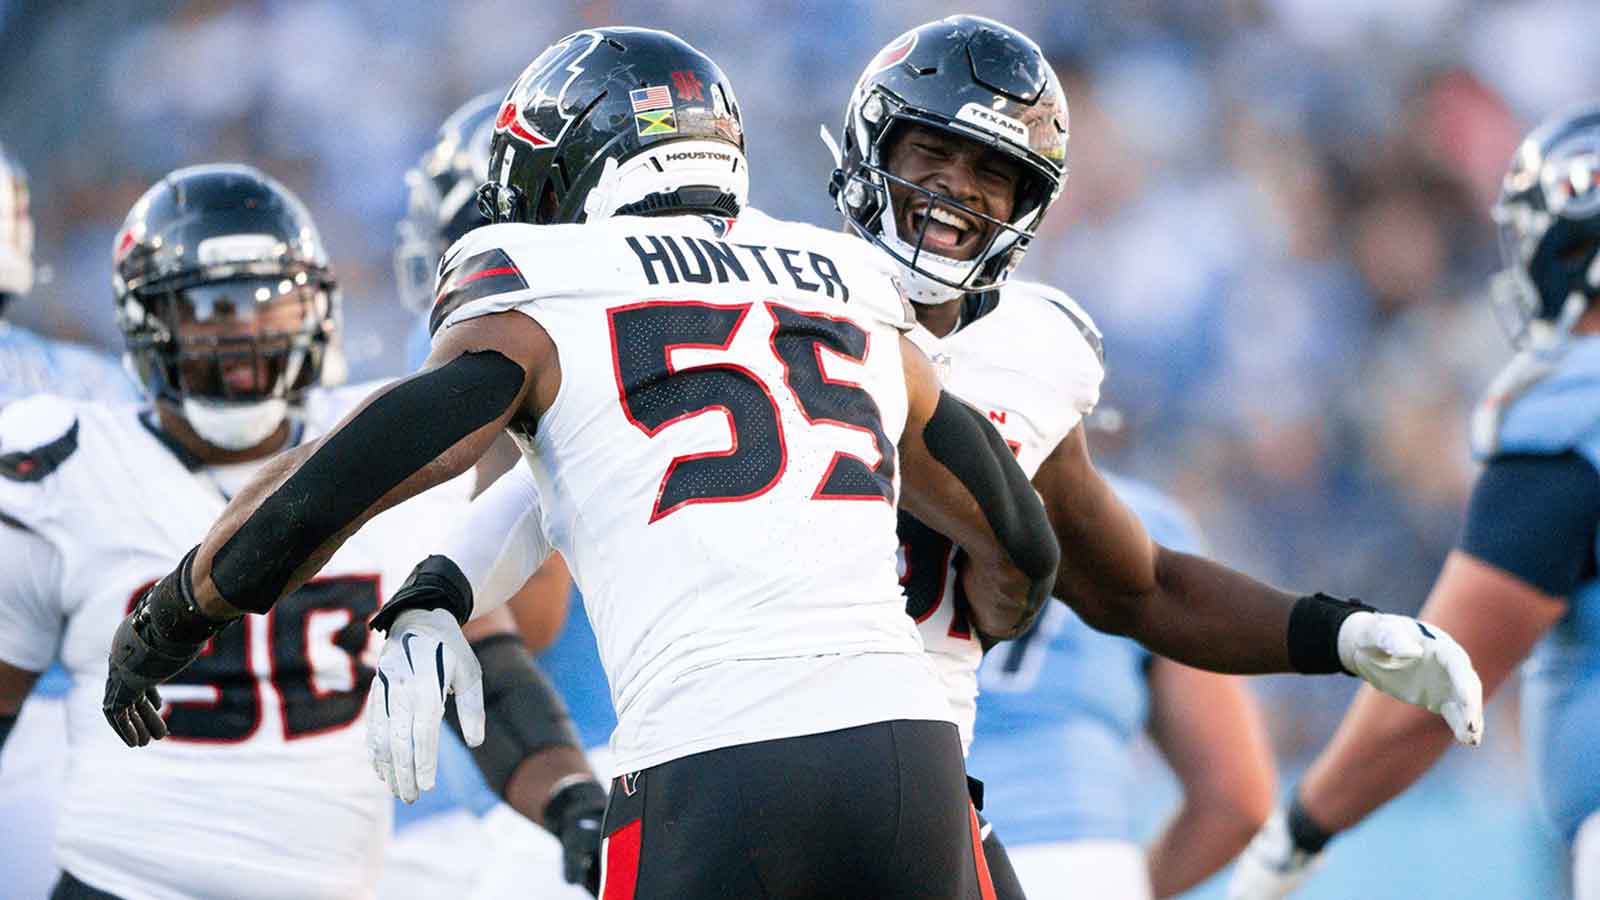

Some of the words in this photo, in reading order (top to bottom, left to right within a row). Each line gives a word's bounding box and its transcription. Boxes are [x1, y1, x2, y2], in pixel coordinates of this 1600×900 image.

[971, 108, 1025, 135] TEXANS
[666, 152, 731, 161] HOUSTON
[624, 235, 849, 303] HUNTER
[606, 300, 896, 525] 55
